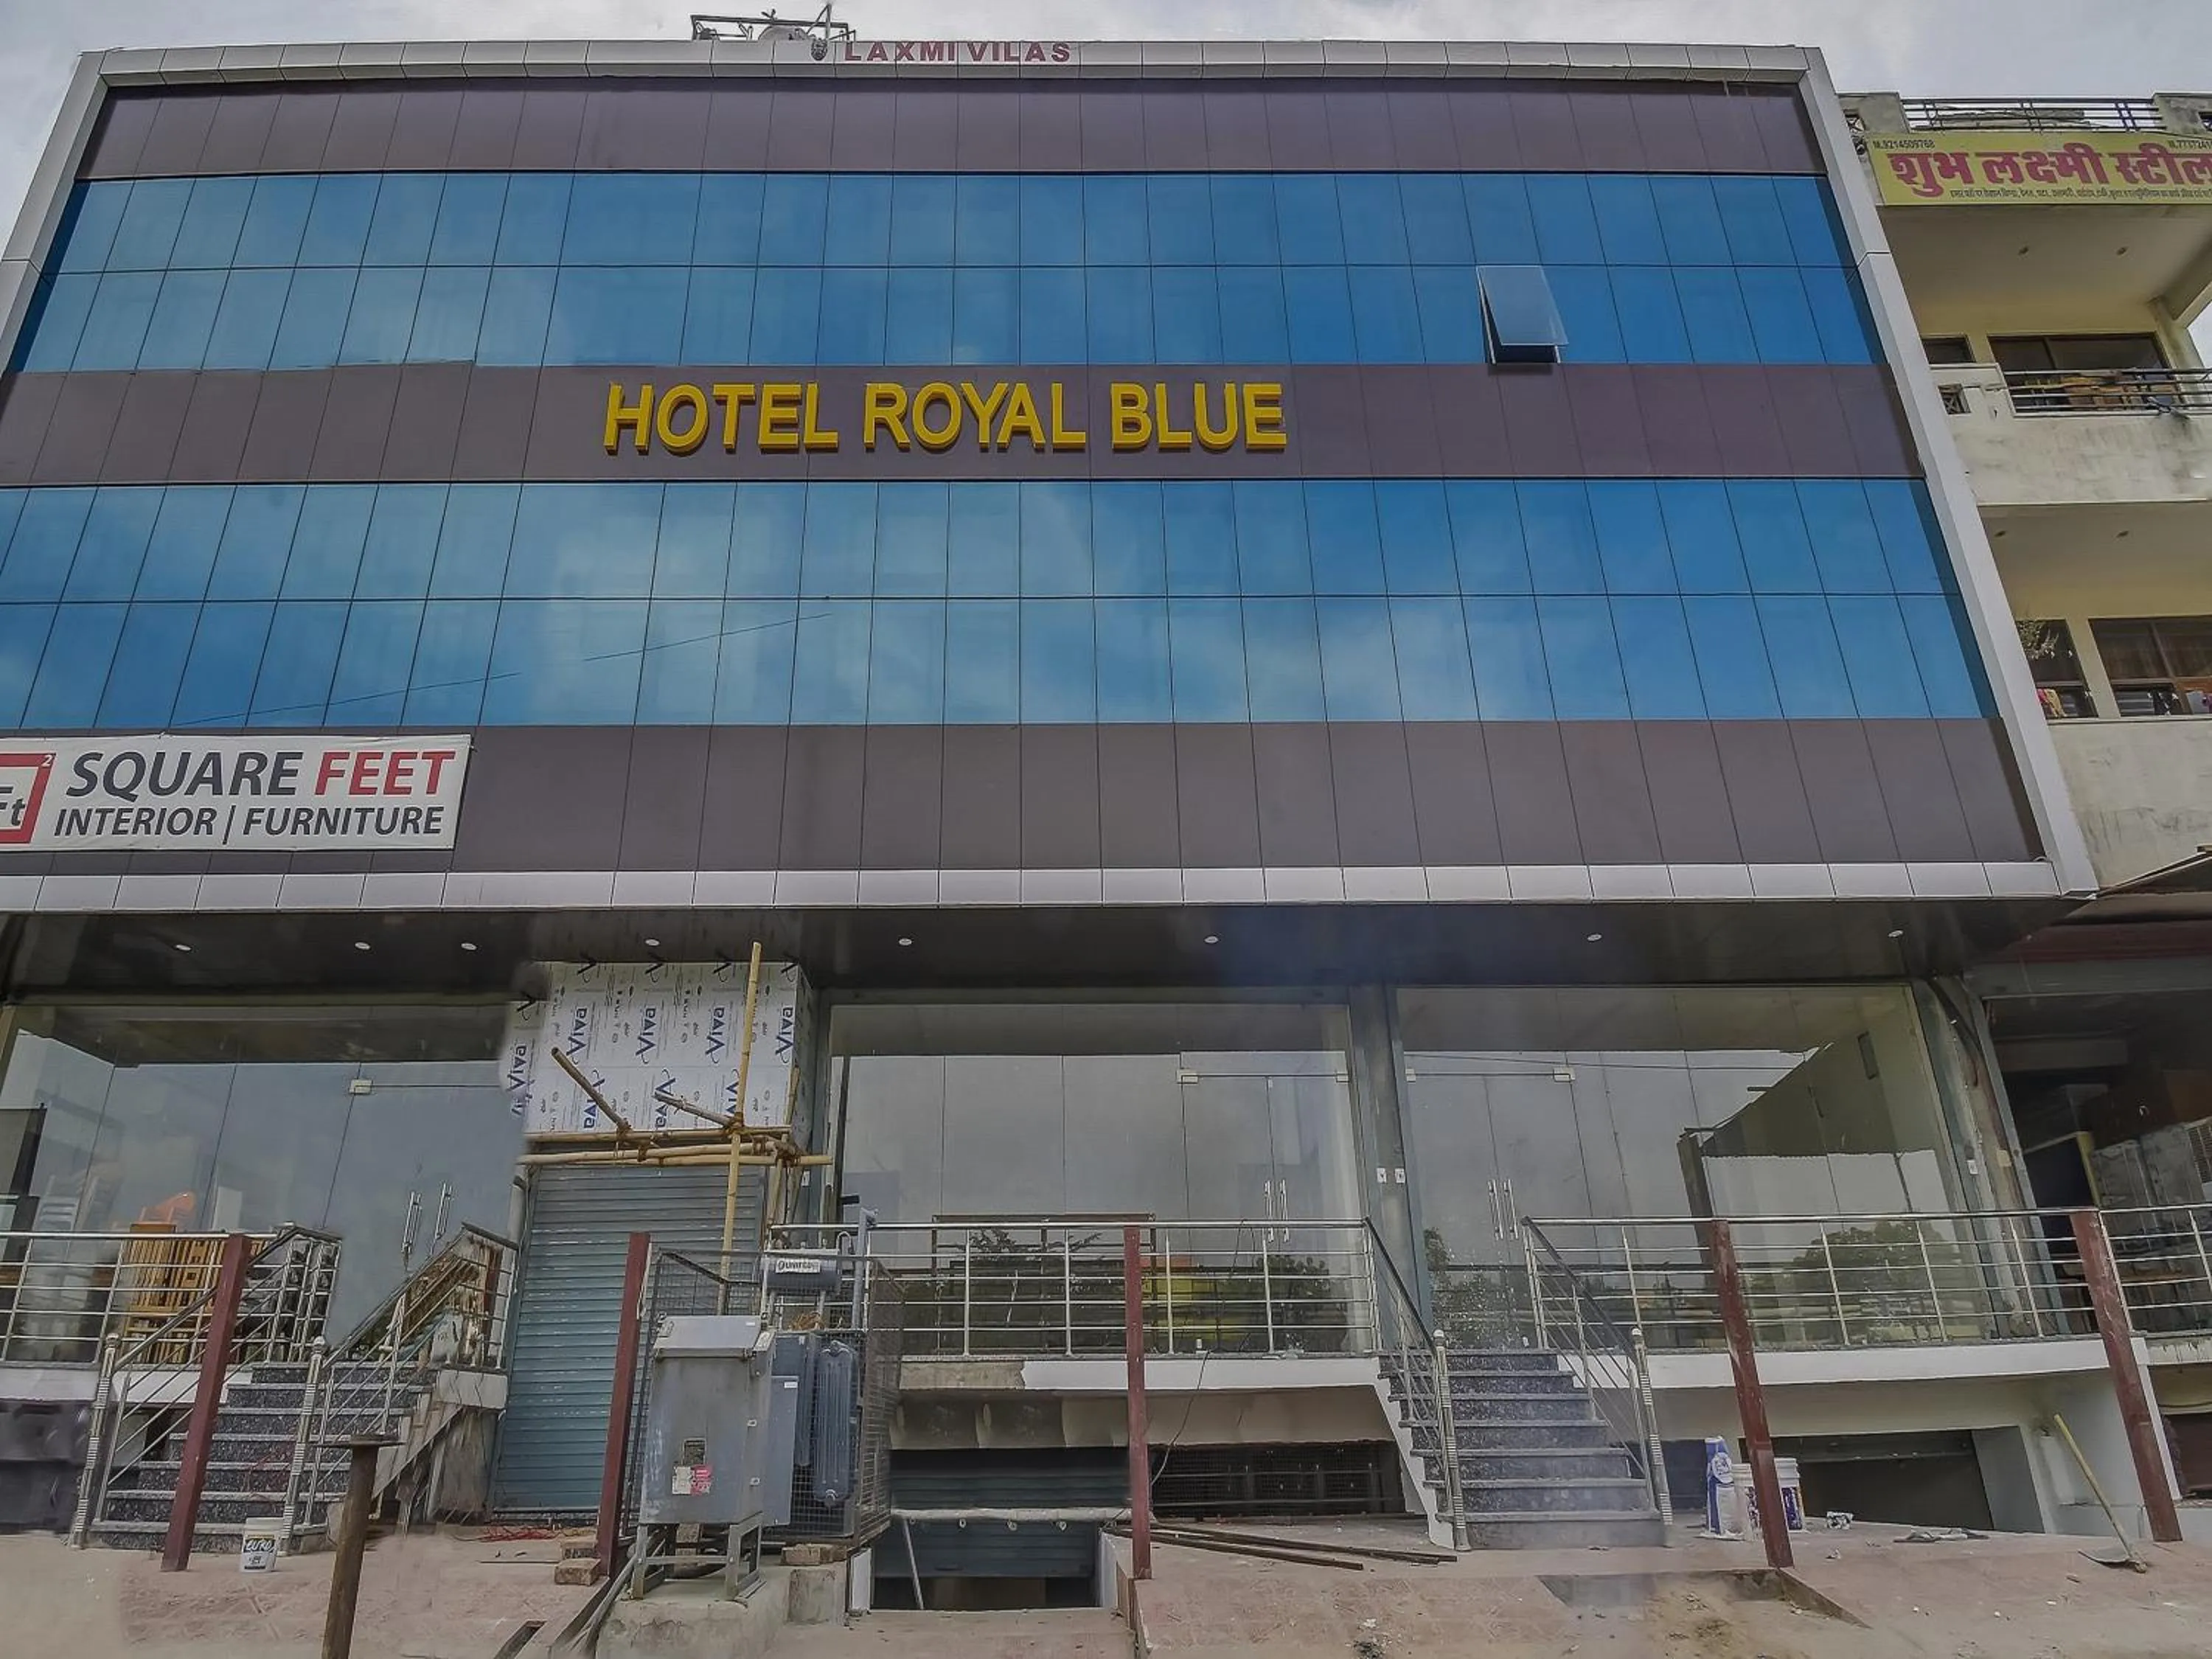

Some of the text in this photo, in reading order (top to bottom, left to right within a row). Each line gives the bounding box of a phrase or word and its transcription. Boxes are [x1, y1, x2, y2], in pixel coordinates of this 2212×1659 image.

[844, 41, 1071, 63] LAXMI VILAS
[1886, 150, 1975, 198] शुभ
[603, 382, 1287, 455] HOTEL ROYAL BLUE
[66, 750, 456, 803] SQUARE FEET
[54, 807, 218, 836] INTERIOR
[243, 805, 445, 836] FURNITURE
